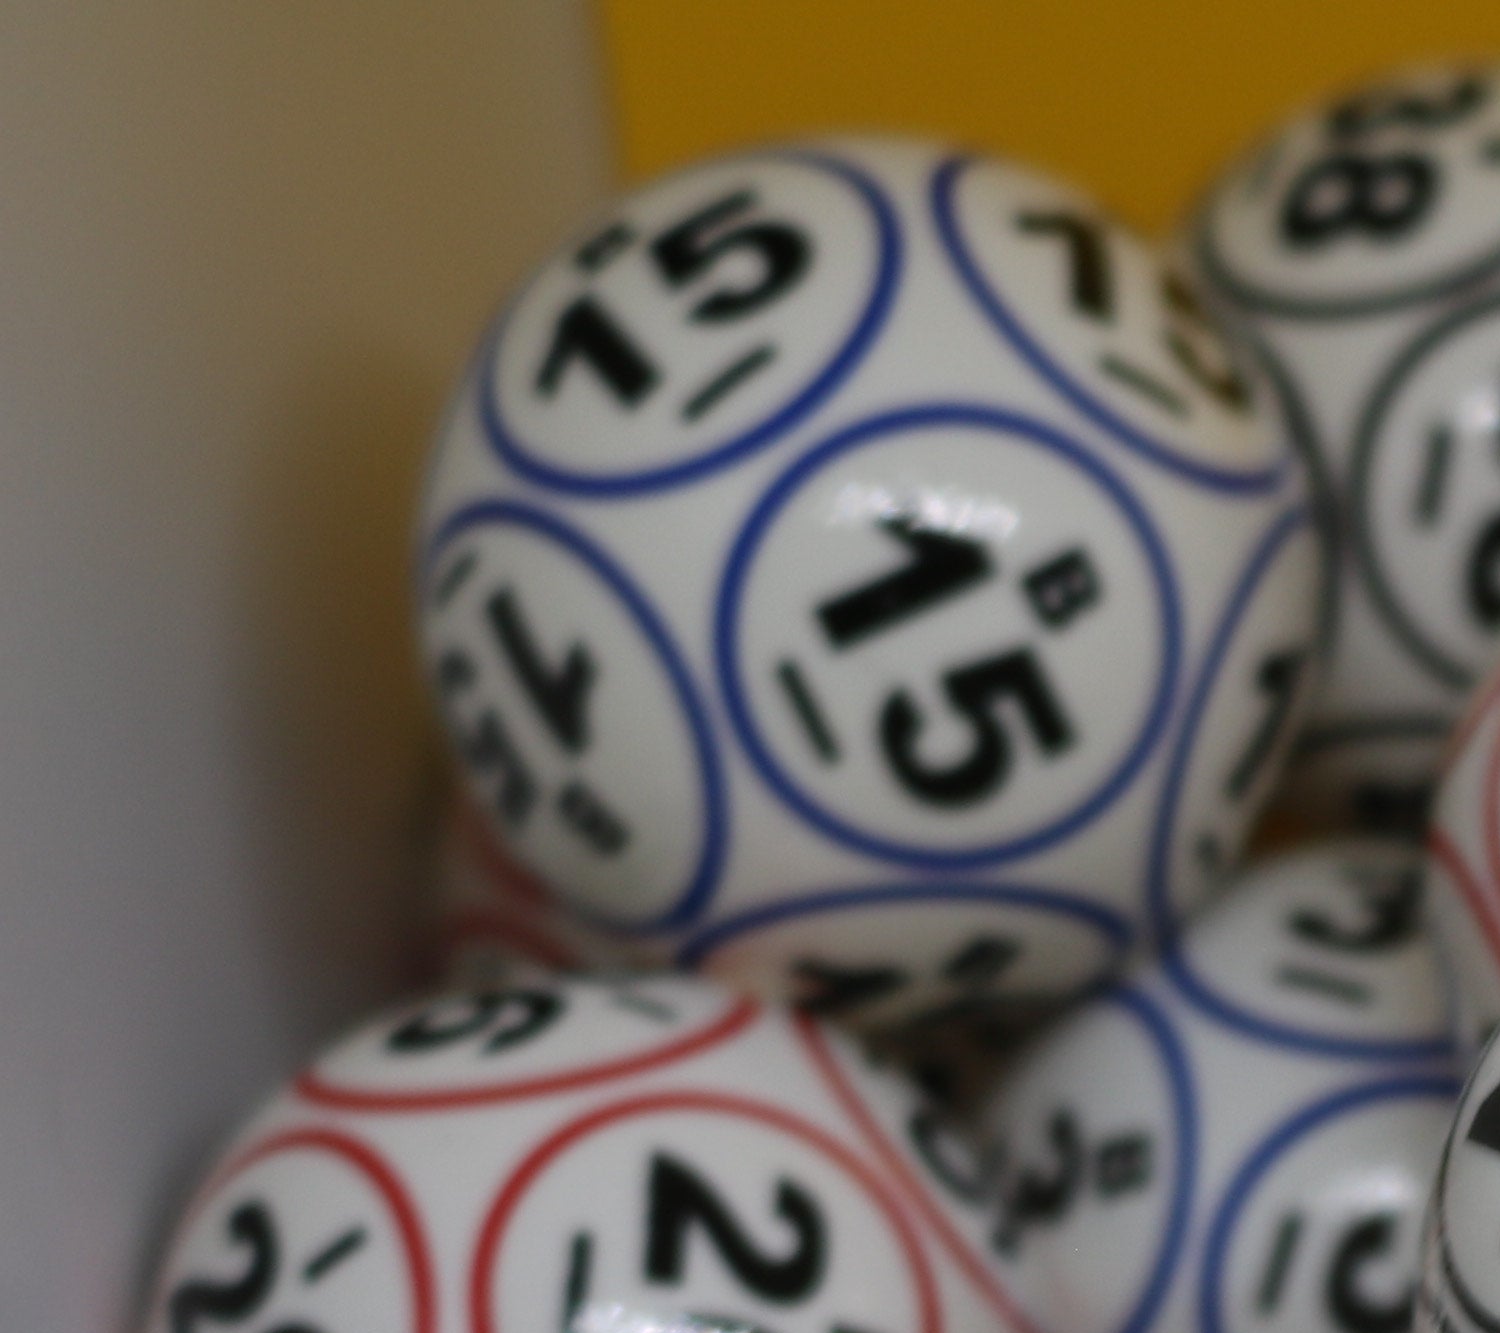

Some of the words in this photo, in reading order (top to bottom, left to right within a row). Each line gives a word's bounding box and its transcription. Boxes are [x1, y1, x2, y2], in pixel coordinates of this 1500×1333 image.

[534, 187, 818, 411] 15
[816, 512, 1079, 815] 15
[1020, 536, 1104, 631] B
